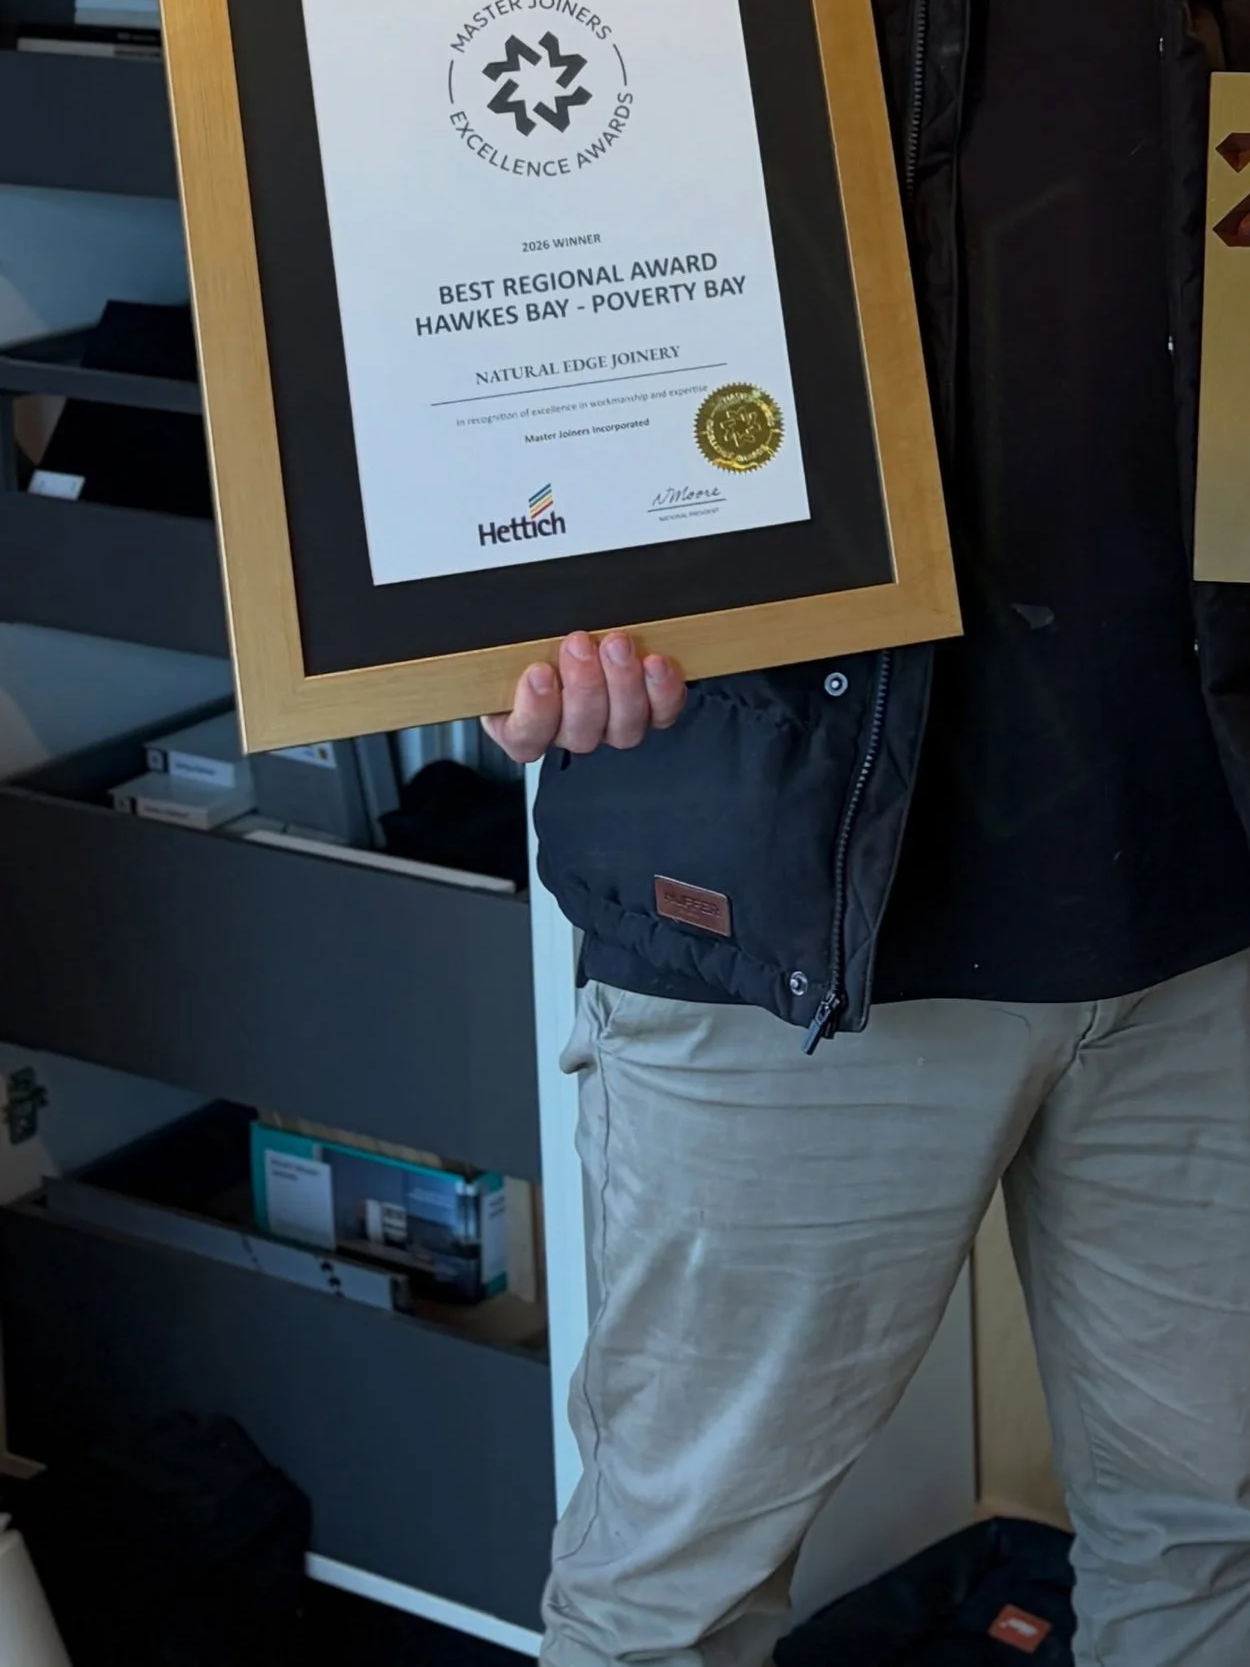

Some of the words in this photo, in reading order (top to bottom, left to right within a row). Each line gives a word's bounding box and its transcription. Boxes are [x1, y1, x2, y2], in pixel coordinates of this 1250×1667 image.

[449, 110, 571, 177] EXCELLENCE
[576, 92, 633, 169] AWARDS
[521, 237, 551, 253] 2026
[552, 233, 602, 248] WINNER
[438, 279, 495, 305] BEST
[502, 263, 625, 297] REGIONAL
[629, 251, 718, 281] AWARD
[415, 304, 519, 337] HAWKES
[525, 298, 570, 323] BAY
[591, 281, 697, 314] POVERTY
[704, 275, 747, 299] BAY
[475, 362, 560, 386] NATURAL
[563, 355, 608, 374] EDGE
[611, 344, 682, 370] JOINERY
[456, 417, 466, 427] In
[467, 412, 518, 426] recognition
[520, 408, 530, 418] of
[531, 404, 577, 417] excellence
[579, 402, 588, 411] in
[589, 392, 649, 409] workmanship
[650, 389, 667, 400] and
[668, 384, 708, 398] expertise
[524, 431, 557, 444] Master
[558, 427, 590, 439] Joiners
[591, 417, 650, 434] Incorporated
[477, 512, 566, 546] Hettich
